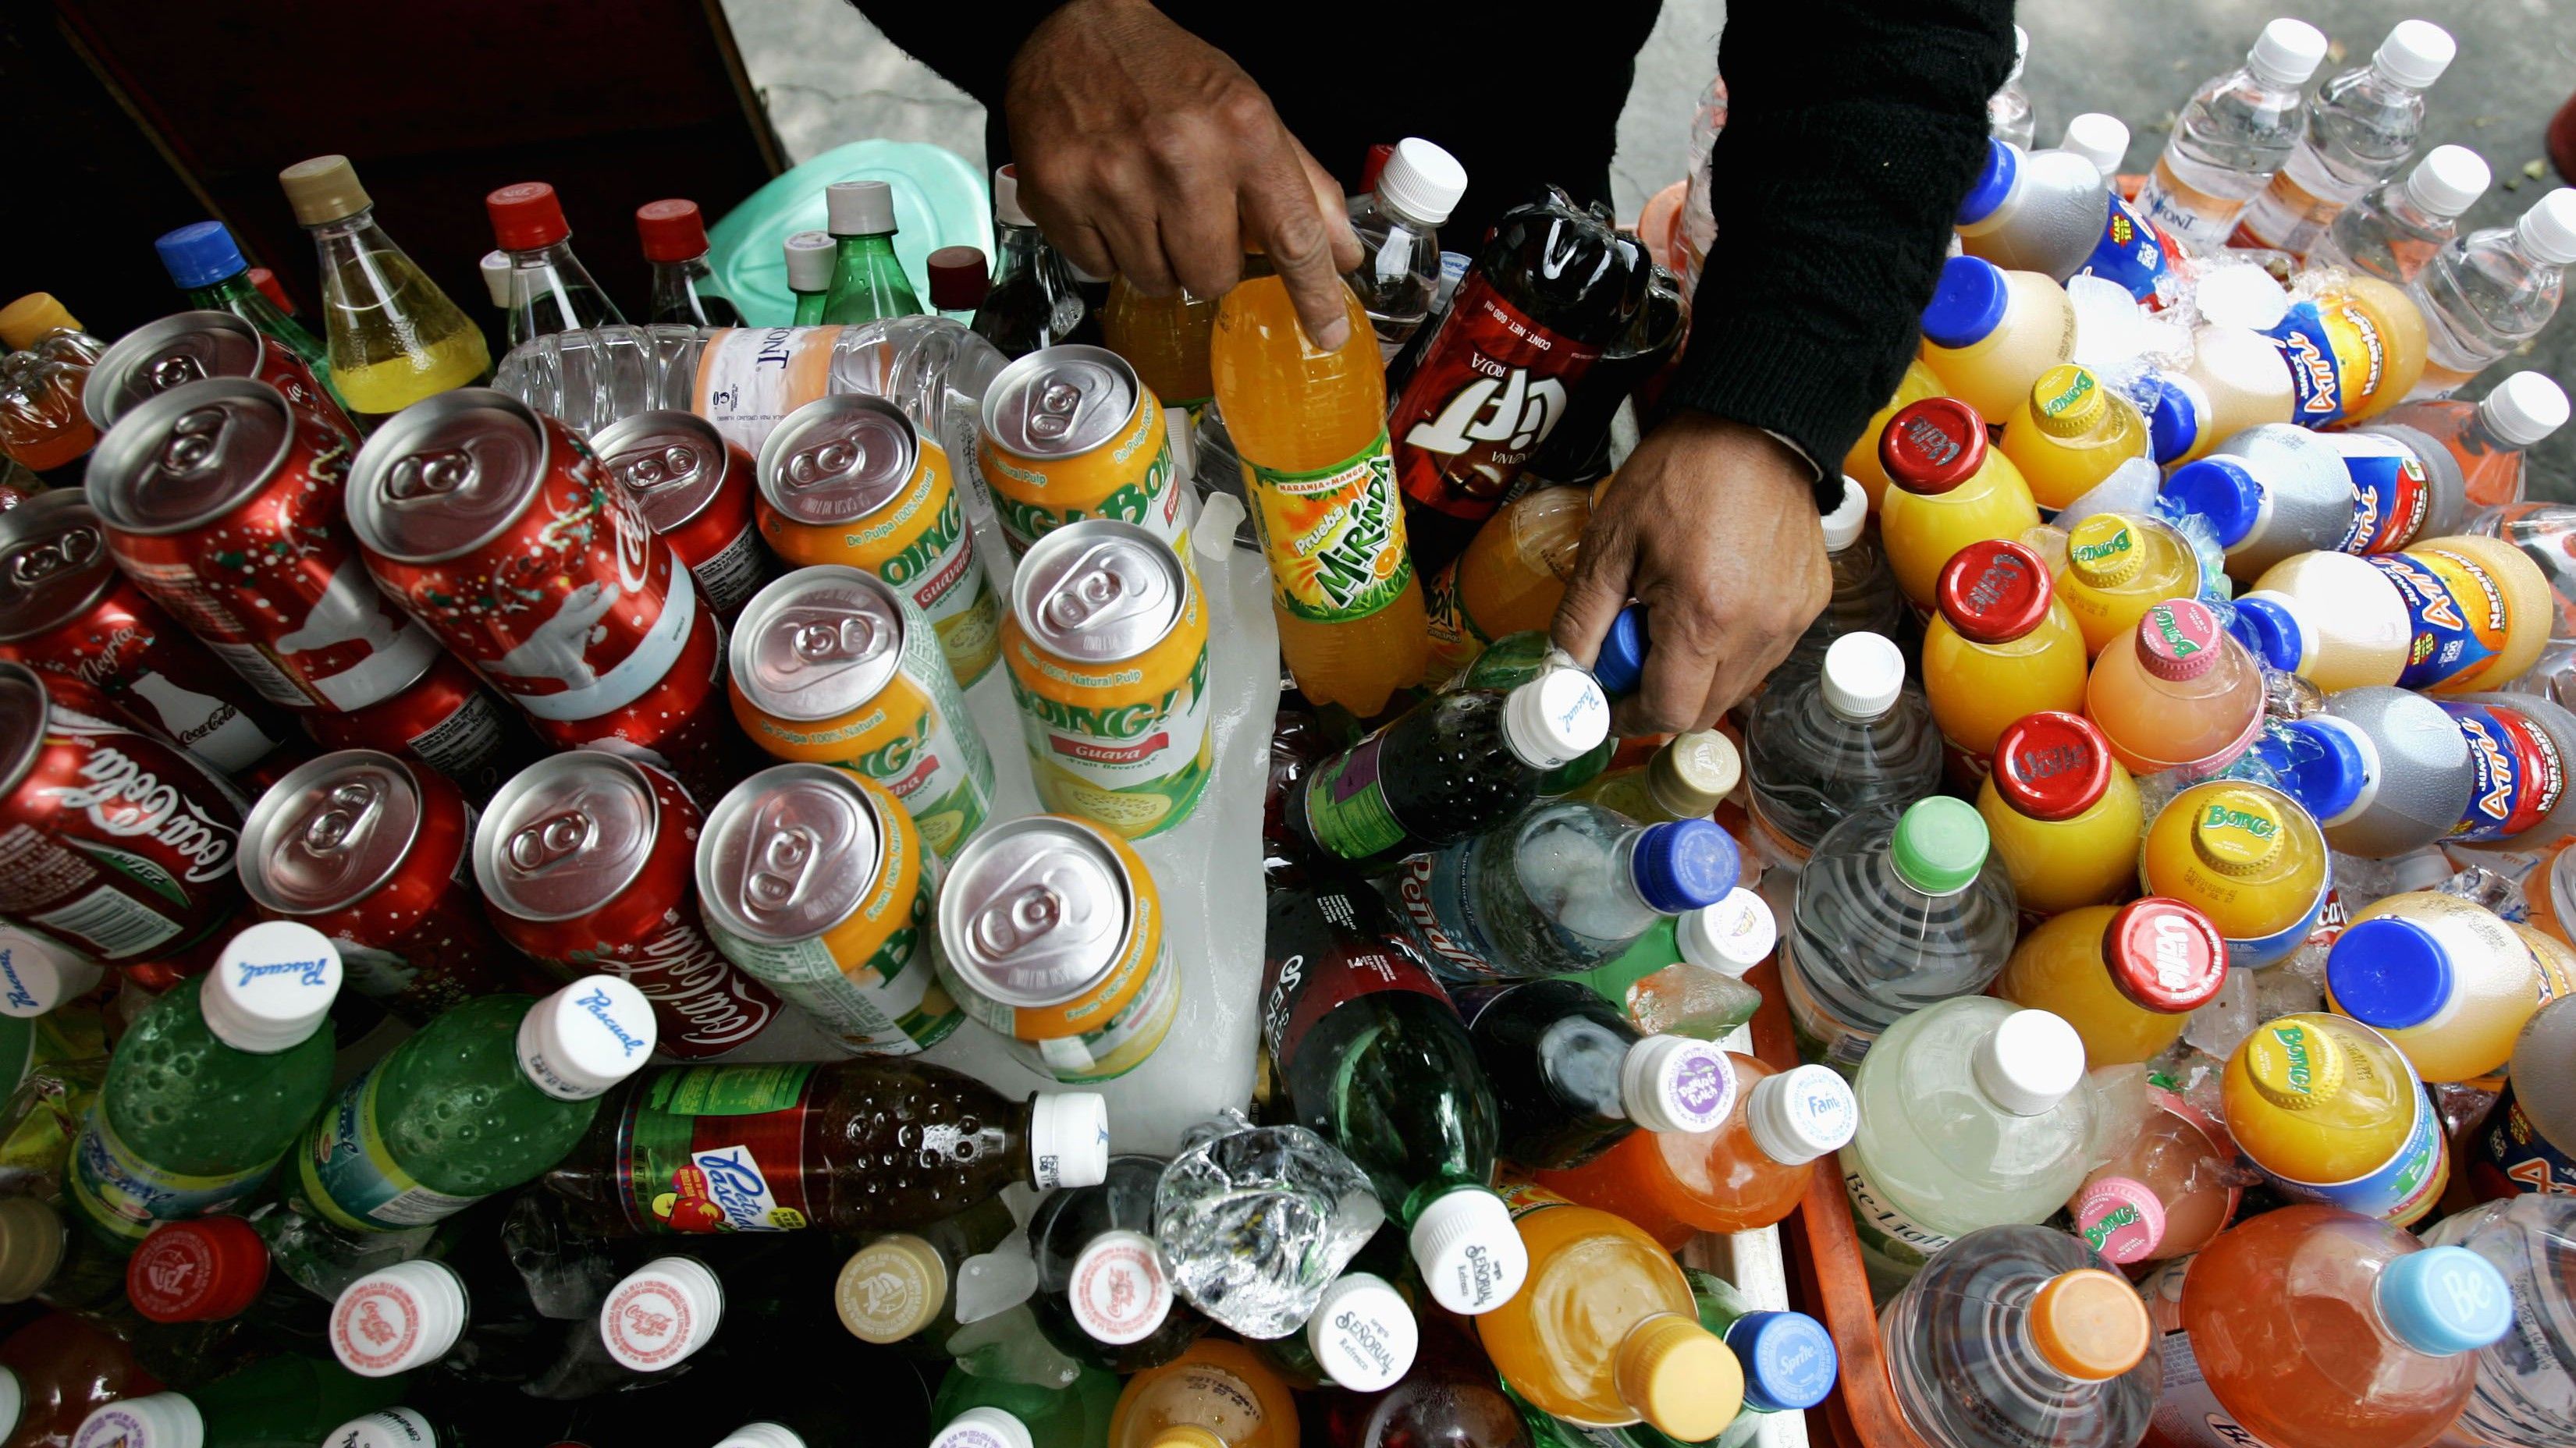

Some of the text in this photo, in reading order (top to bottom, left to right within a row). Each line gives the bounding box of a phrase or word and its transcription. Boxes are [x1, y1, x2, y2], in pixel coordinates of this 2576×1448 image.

[1471, 352, 1507, 378] ROJA
[1294, 506, 1346, 557] Prueba
[1115, 668, 1142, 685] Pulp
[1075, 744, 1142, 761] Guava
[2203, 804, 2283, 843] BOING!
[2272, 1025, 2312, 1096] BOING!
[1845, 1172, 1953, 1249] Be-Ligh
[1339, 1337, 1369, 1371] Refresco
[1778, 1342, 1817, 1377] Sprite
